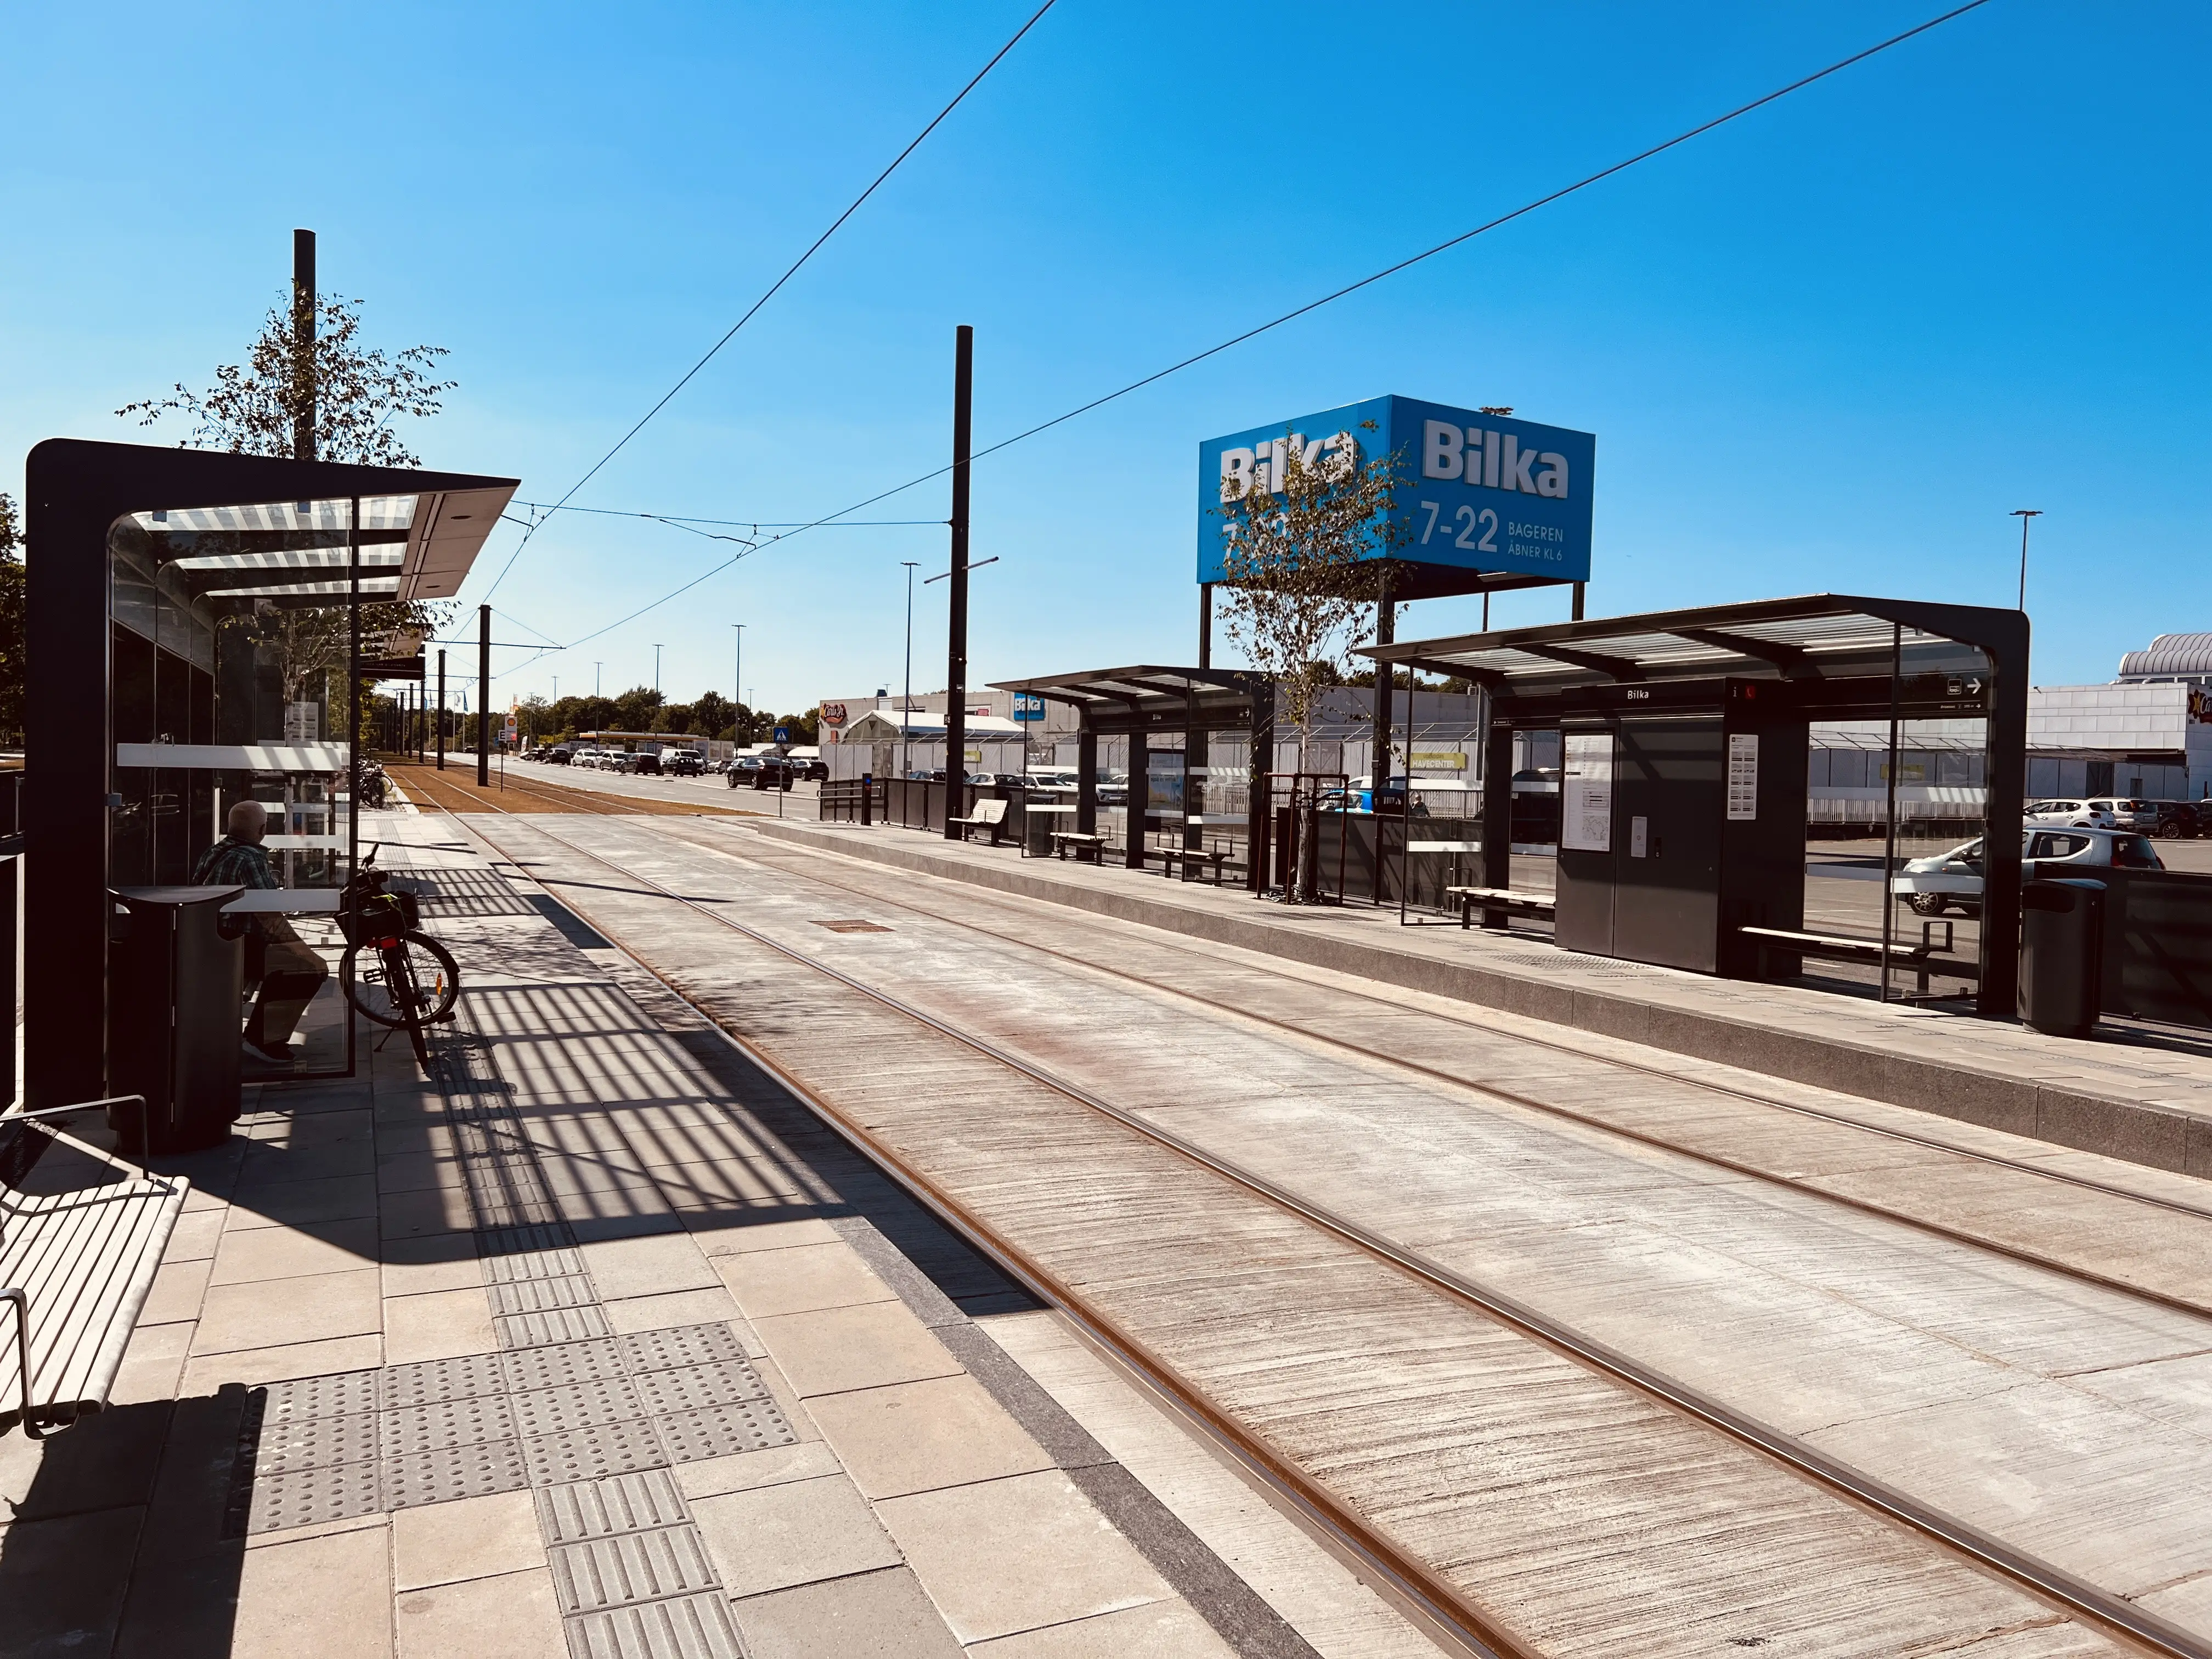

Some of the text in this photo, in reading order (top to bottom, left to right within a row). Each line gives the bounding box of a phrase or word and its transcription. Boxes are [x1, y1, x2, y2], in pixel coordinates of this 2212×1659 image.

[1220, 432, 1356, 503] Bilka
[1423, 419, 1568, 499] Bilka
[1421, 500, 1498, 553] 7-22
[1509, 522, 1563, 543] BAGEREN
[1508, 540, 1562, 561] ÅBNER KL 6
[1627, 690, 1649, 699] Bilka
[1413, 760, 1455, 769] HAVECENTER
